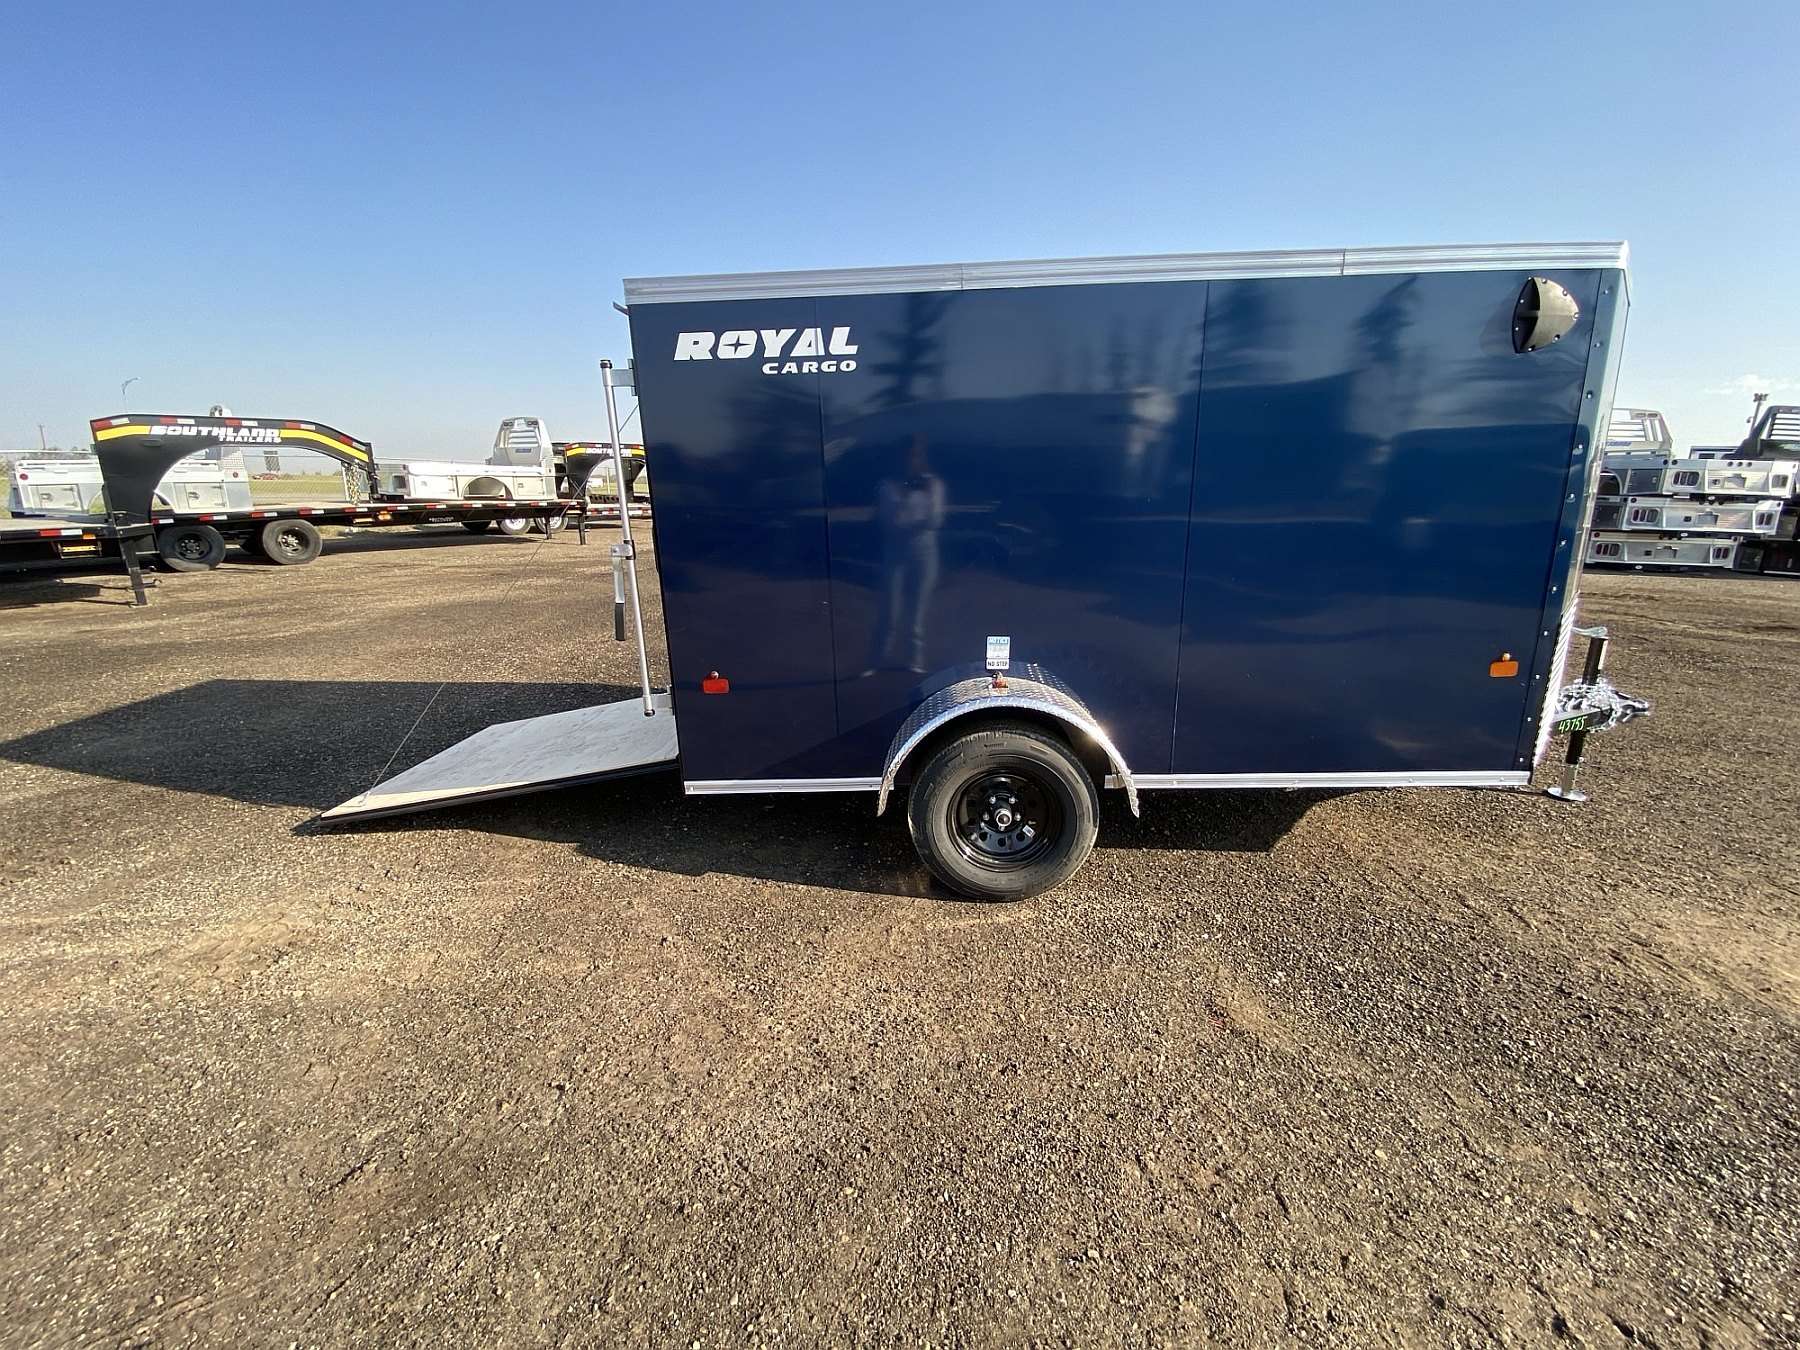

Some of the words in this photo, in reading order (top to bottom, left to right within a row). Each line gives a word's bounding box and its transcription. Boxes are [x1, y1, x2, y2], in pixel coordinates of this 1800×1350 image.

[673, 326, 858, 361] ROYAL
[761, 360, 857, 375] CARGO
[150, 425, 281, 437] SOUTHLAND
[218, 435, 282, 443] TRAILERS
[1558, 716, 1588, 733] 43755
